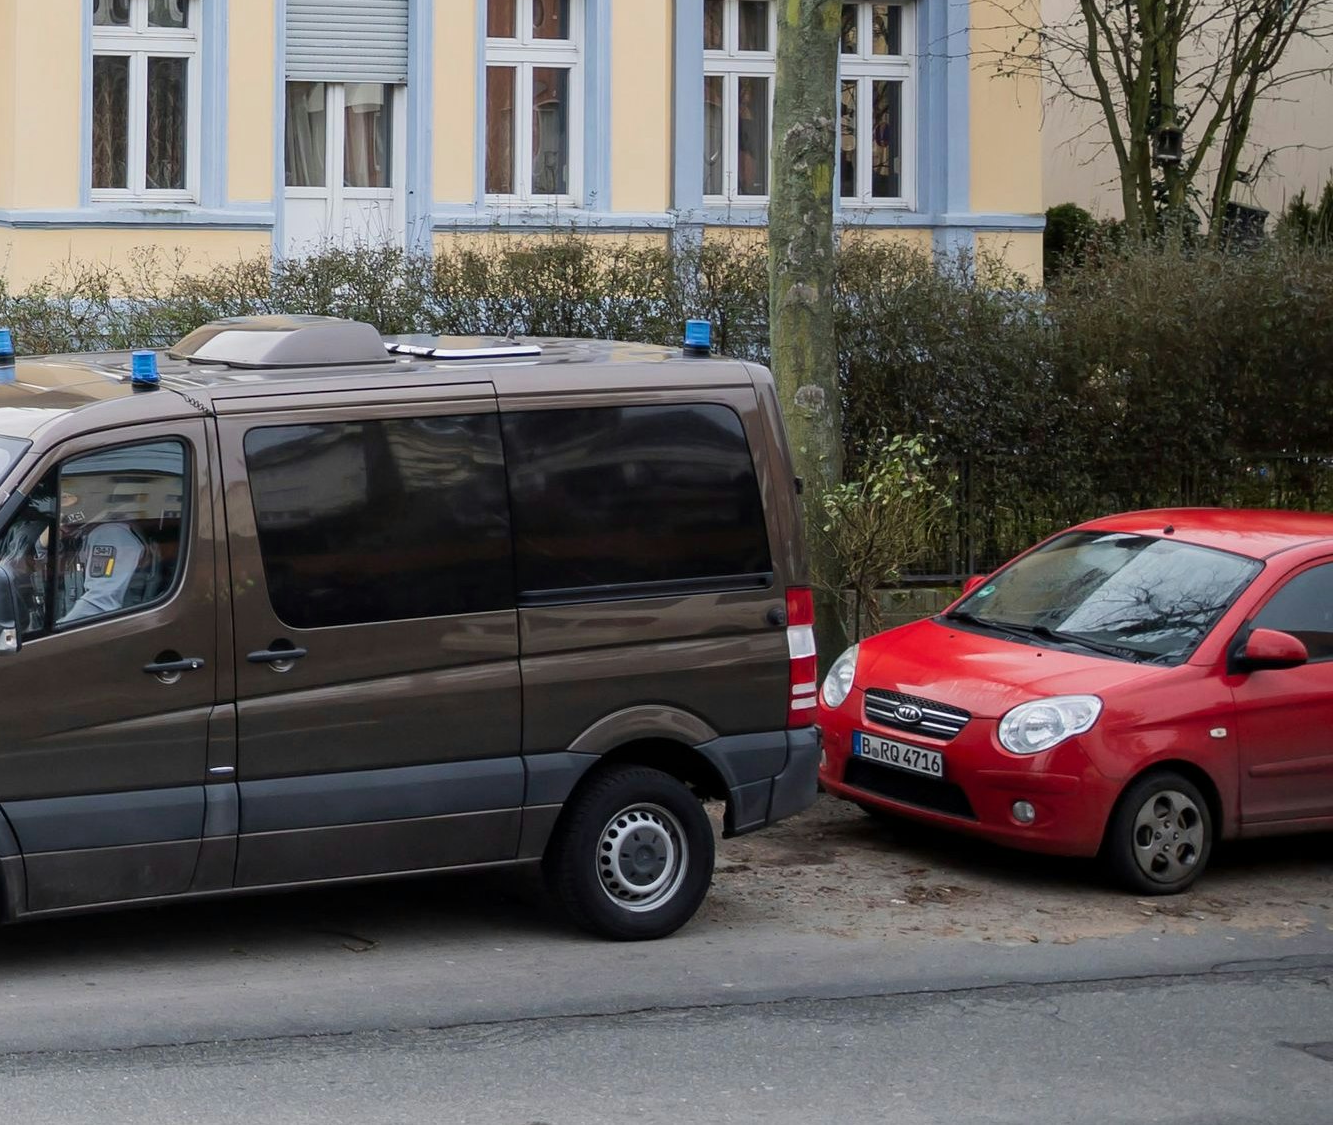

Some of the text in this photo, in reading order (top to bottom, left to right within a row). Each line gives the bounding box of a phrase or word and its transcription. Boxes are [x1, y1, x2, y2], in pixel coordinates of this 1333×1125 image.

[898, 707, 917, 719] KIA
[862, 736, 941, 773] B RQ 4716
